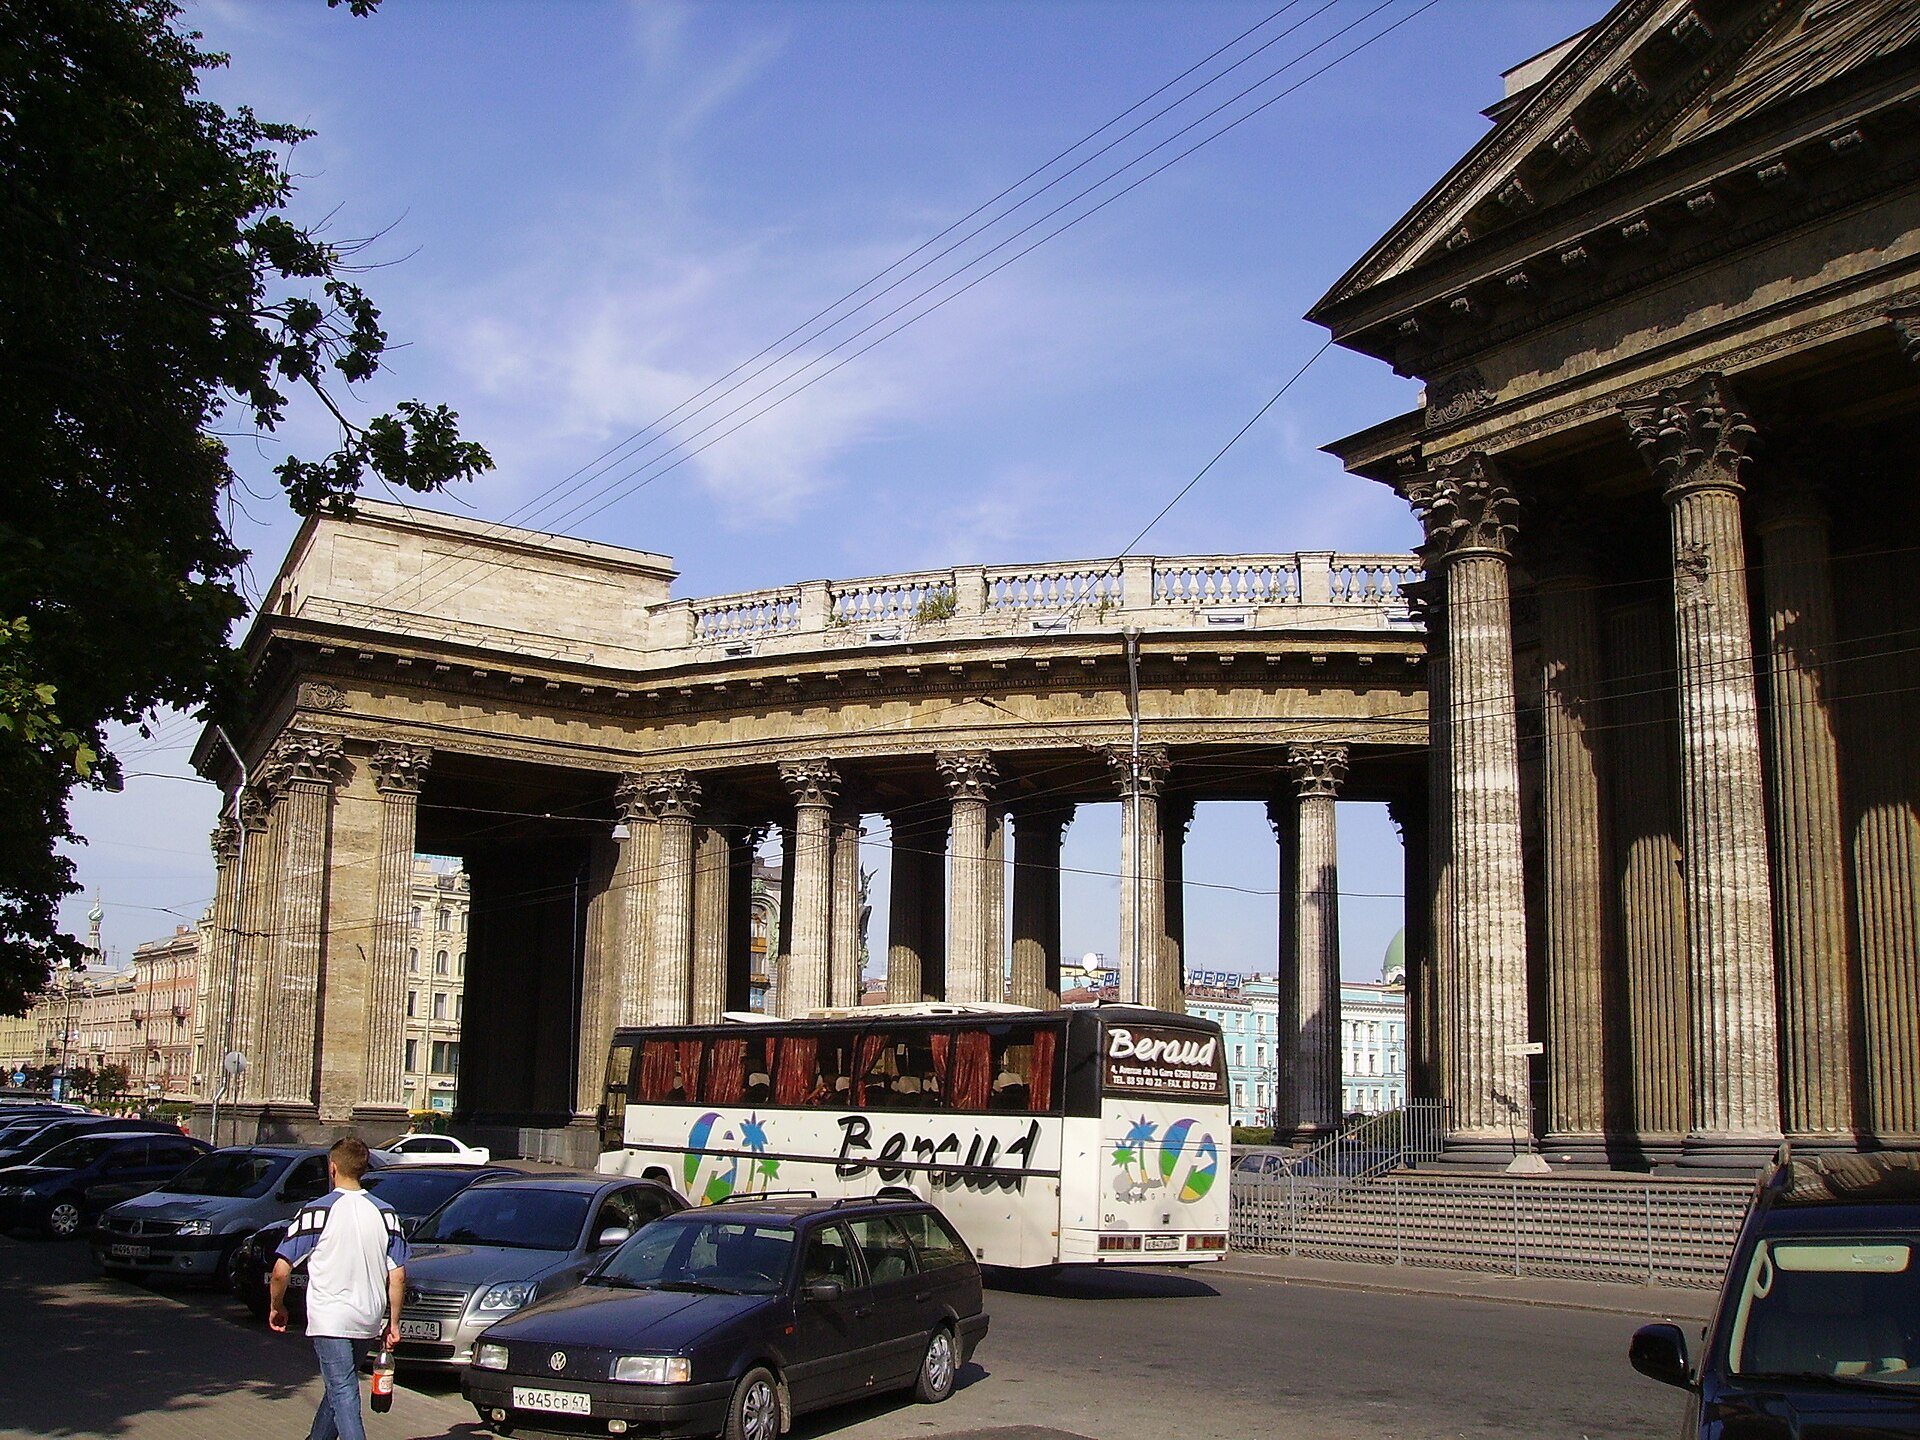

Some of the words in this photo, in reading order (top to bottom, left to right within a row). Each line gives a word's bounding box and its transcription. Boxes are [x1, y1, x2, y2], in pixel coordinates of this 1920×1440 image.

[1192, 970, 1243, 987] PEPSI
[1108, 1028, 1216, 1066] Beraud
[1142, 1067, 1151, 1076] de
[836, 1116, 1042, 1196] Beraud
[425, 1323, 435, 1332] 78
[572, 1396, 585, 1407] 47
